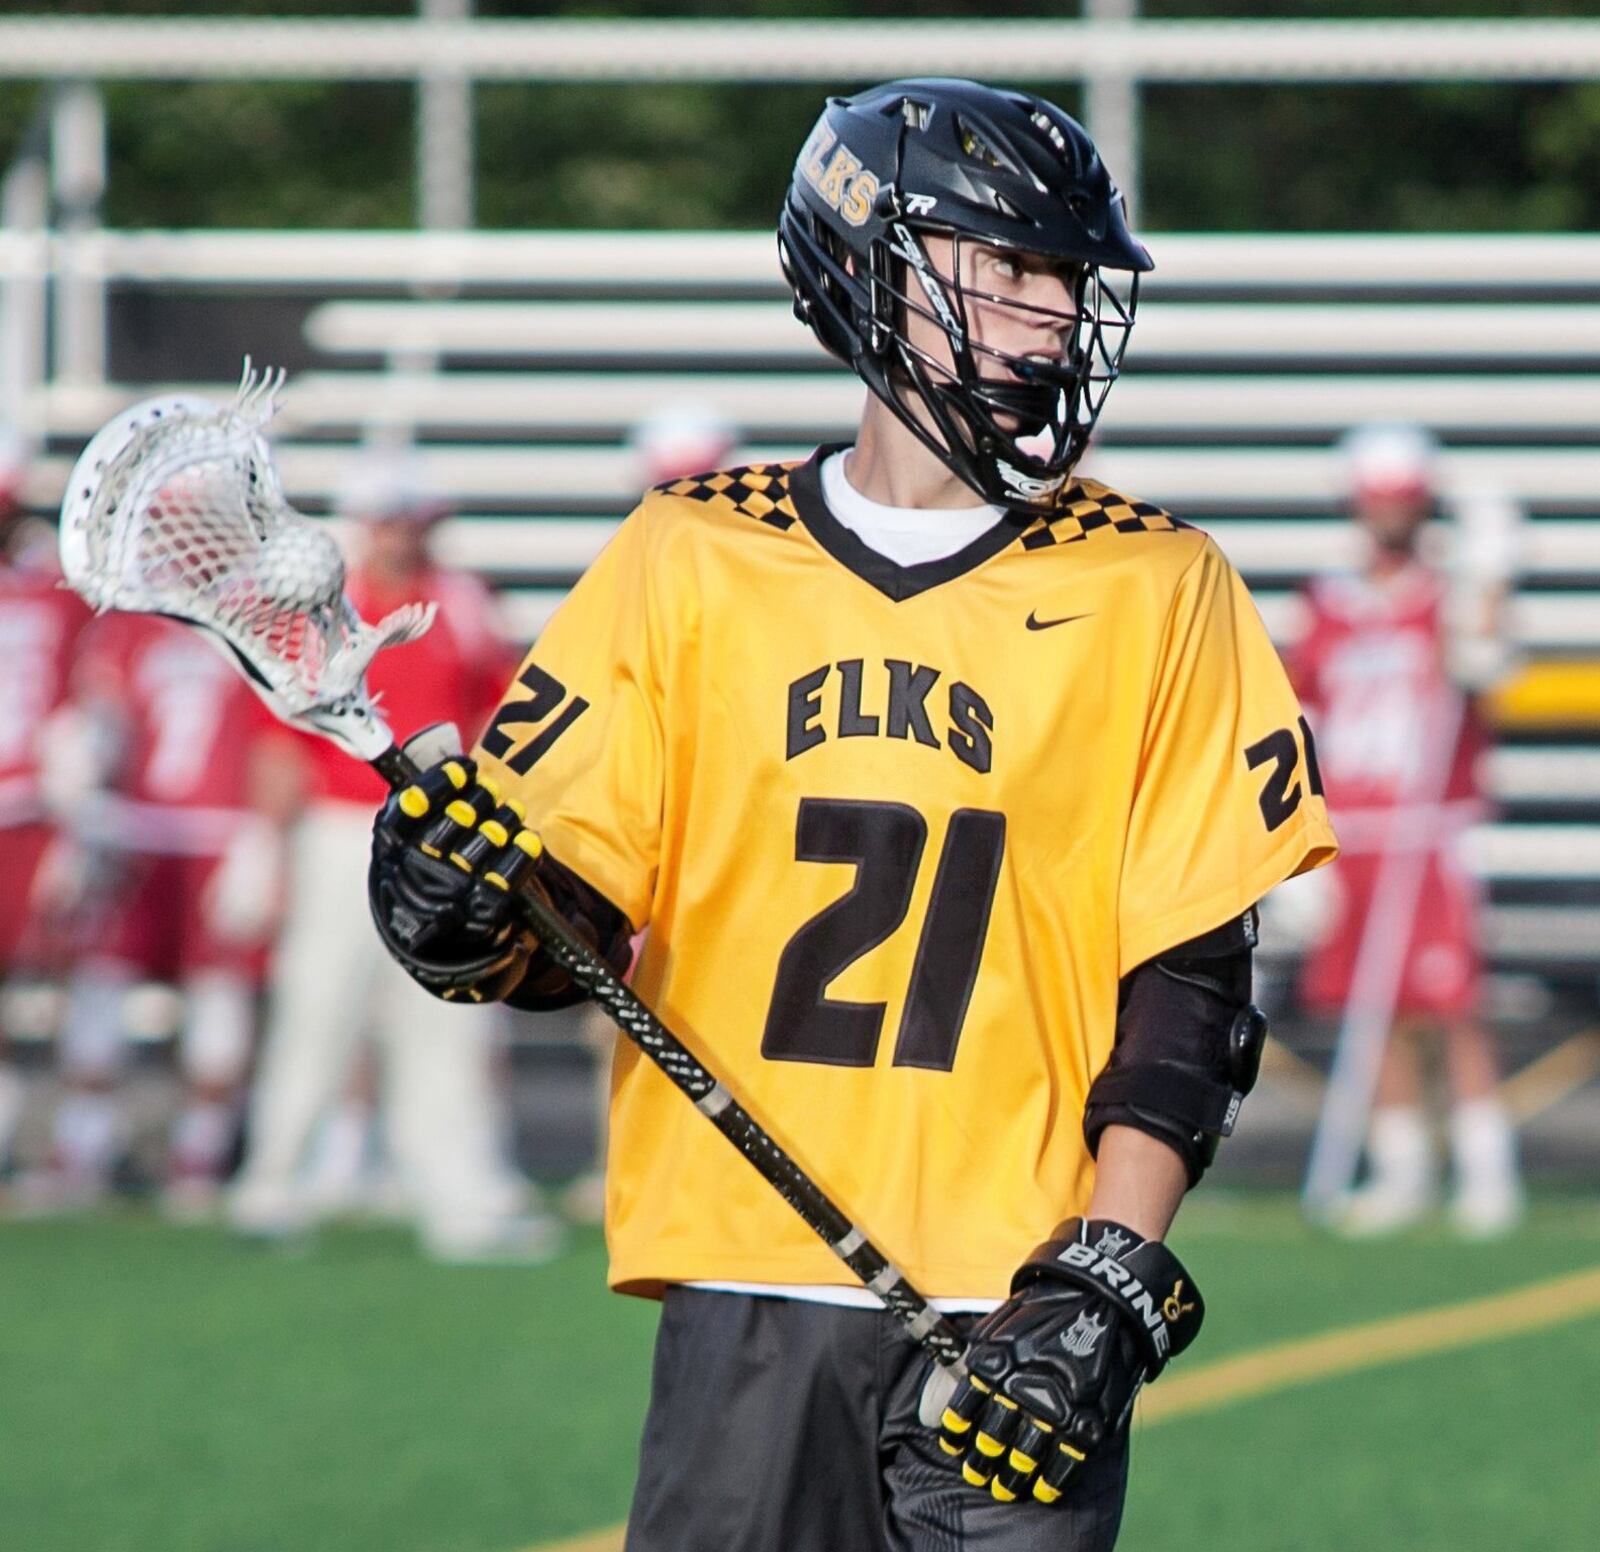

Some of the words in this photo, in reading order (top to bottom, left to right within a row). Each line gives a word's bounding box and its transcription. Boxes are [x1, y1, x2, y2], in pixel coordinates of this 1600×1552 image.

[481, 662, 590, 777] 21
[786, 658, 993, 774] ELKS
[1244, 714, 1324, 833] 21
[761, 796, 1007, 1073] 21
[1057, 1242, 1171, 1359] BRINE
